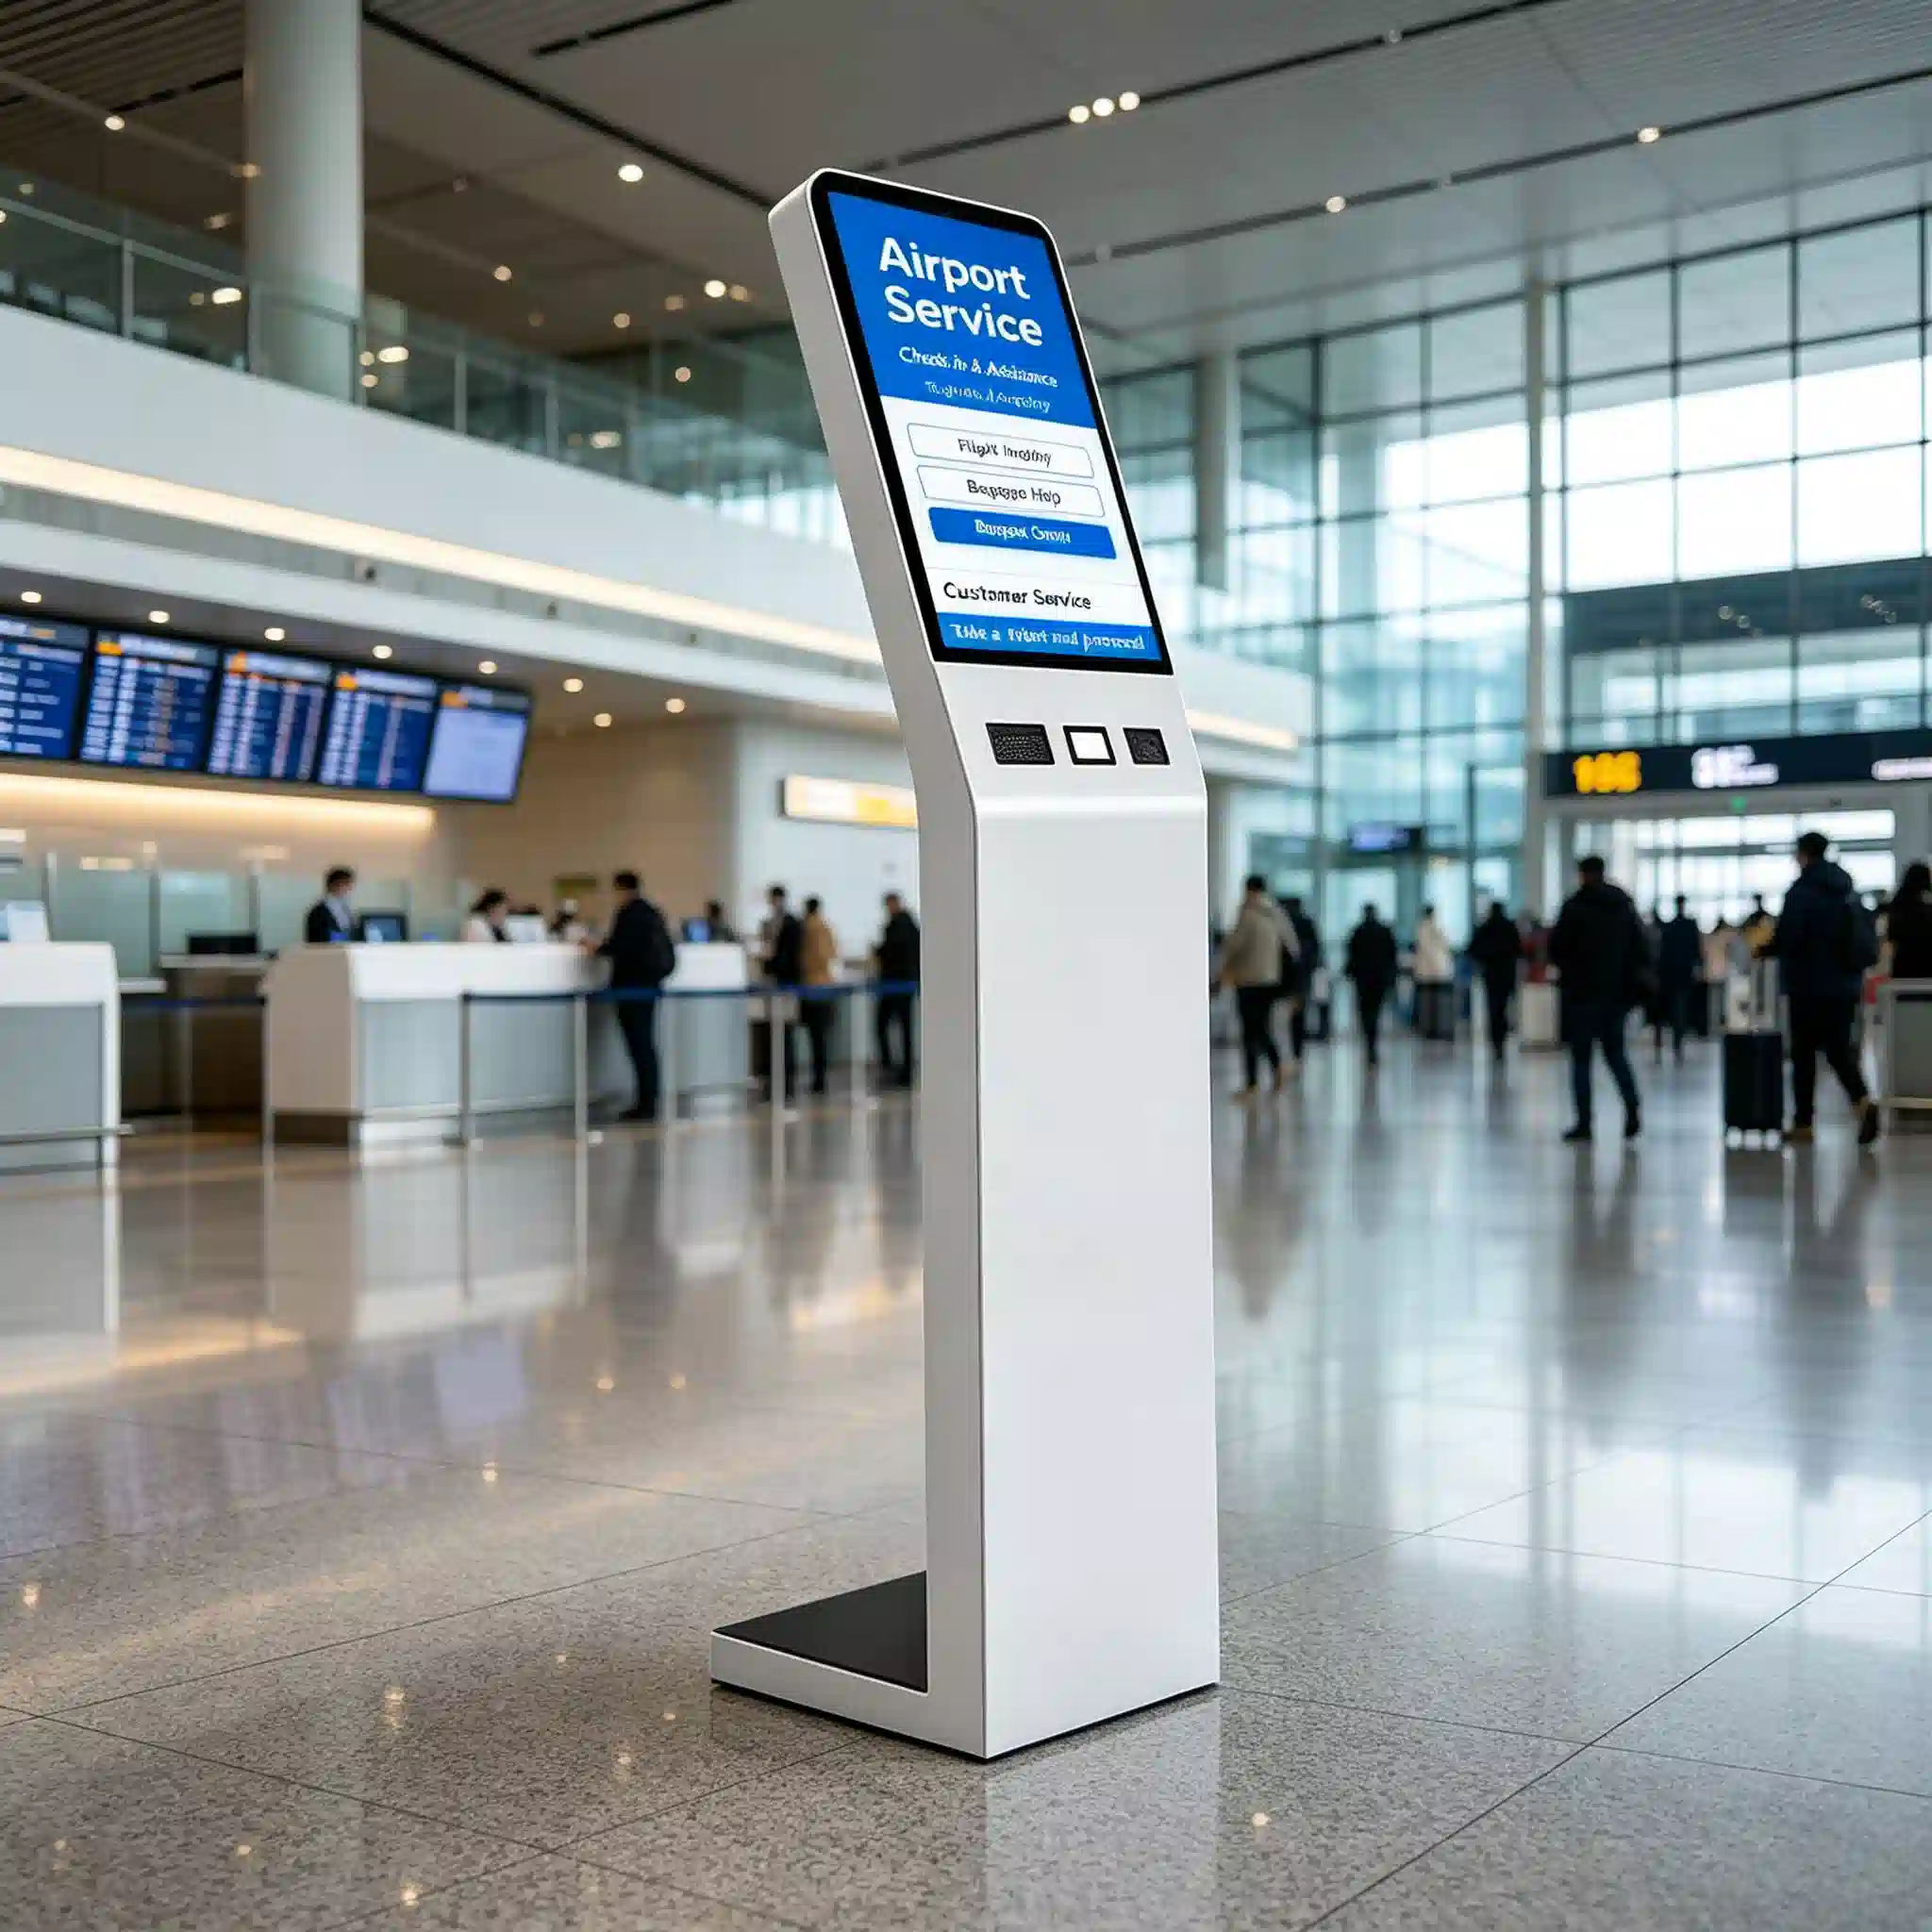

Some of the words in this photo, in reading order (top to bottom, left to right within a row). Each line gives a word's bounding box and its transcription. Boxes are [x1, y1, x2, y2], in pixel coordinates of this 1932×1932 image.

[880, 237, 1030, 300] Airport
[884, 285, 1042, 346] Service
[943, 582, 1027, 604] Customer
[1033, 589, 1091, 609] Service
